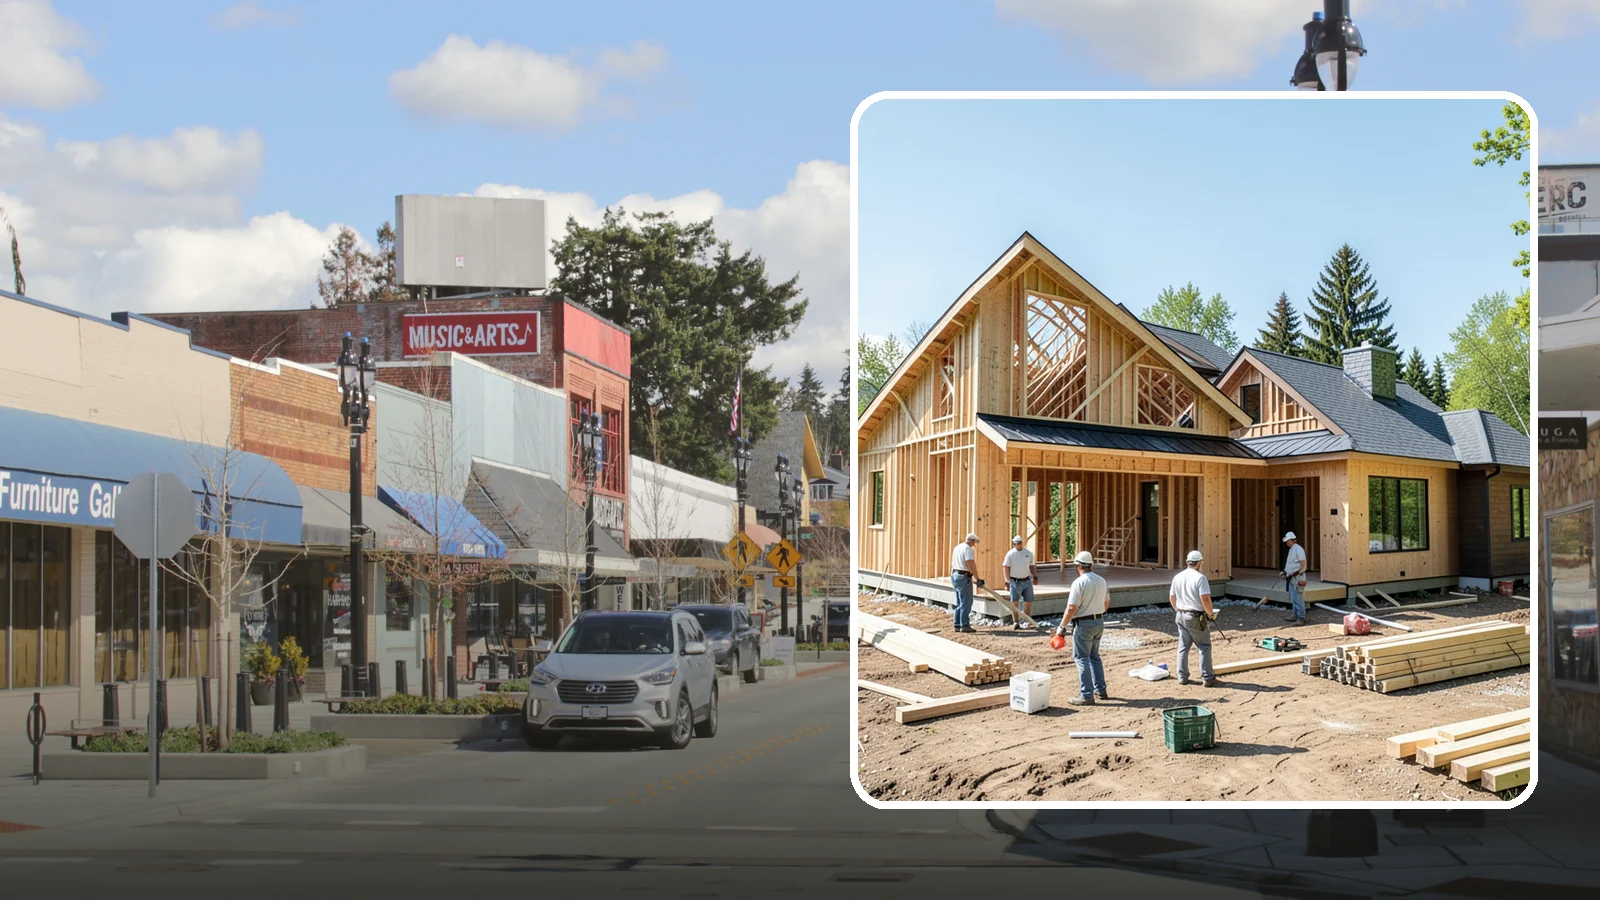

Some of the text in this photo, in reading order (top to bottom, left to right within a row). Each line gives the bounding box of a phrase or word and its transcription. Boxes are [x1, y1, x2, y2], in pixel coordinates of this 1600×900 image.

[409, 323, 519, 349] MUSIC&ARTS
[0, 472, 79, 515] Furniture
[453, 563, 479, 574] SUSHI
